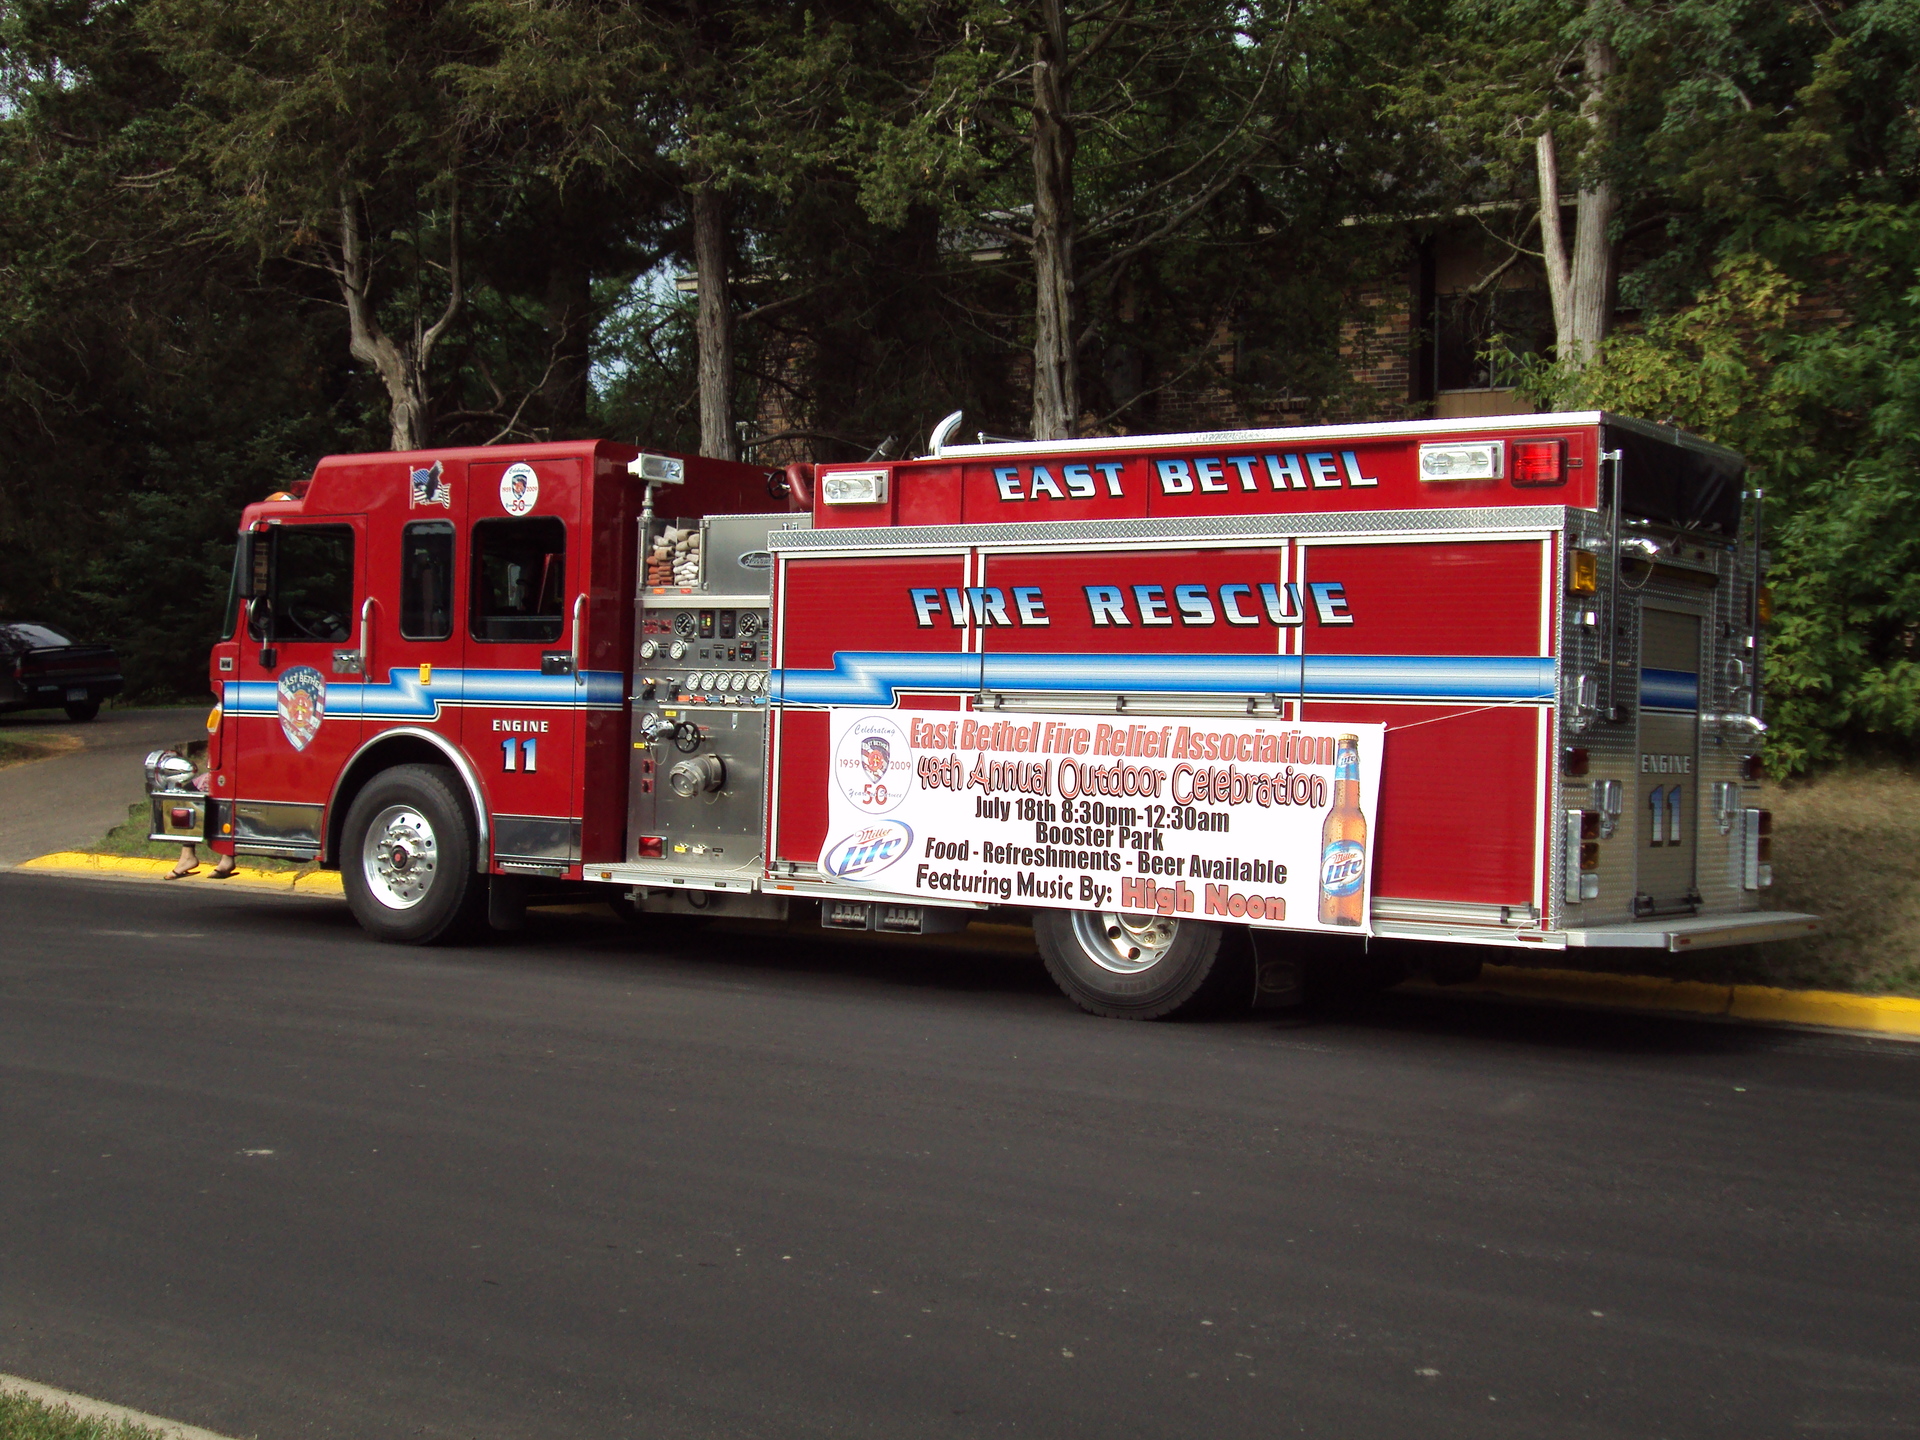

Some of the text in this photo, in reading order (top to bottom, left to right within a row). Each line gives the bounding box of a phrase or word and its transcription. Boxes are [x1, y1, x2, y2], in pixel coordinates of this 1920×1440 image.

[993, 450, 1379, 501] EAST BETHEL
[512, 499, 525, 512] 50
[908, 581, 1355, 628] FIRE RESCUE
[492, 719, 549, 733] ENGINE
[855, 724, 896, 737] Celebrating
[501, 737, 537, 774] 11
[910, 717, 1335, 766] East Bethel Fire Relief Association
[839, 759, 911, 771] 1959 2009
[1340, 755, 1356, 766] Lite
[1641, 754, 1691, 774] ENGINE
[917, 752, 1327, 808] 48th Annual Outdoor Celebration
[862, 784, 888, 806] 50
[975, 796, 1230, 833] July 18th 8:30pm-12:30am
[1649, 784, 1682, 847] 11
[855, 828, 893, 842] Miller
[1036, 822, 1164, 851] Booster Park
[837, 838, 902, 877] Lite
[925, 837, 969, 861] Food
[983, 841, 1121, 872] Refreshments
[1137, 851, 1187, 877] Beer
[1189, 855, 1288, 885] Available
[1326, 859, 1362, 884] Lite
[1333, 853, 1357, 863] Miller
[916, 864, 1286, 921] Featuring Music By: High Noon
